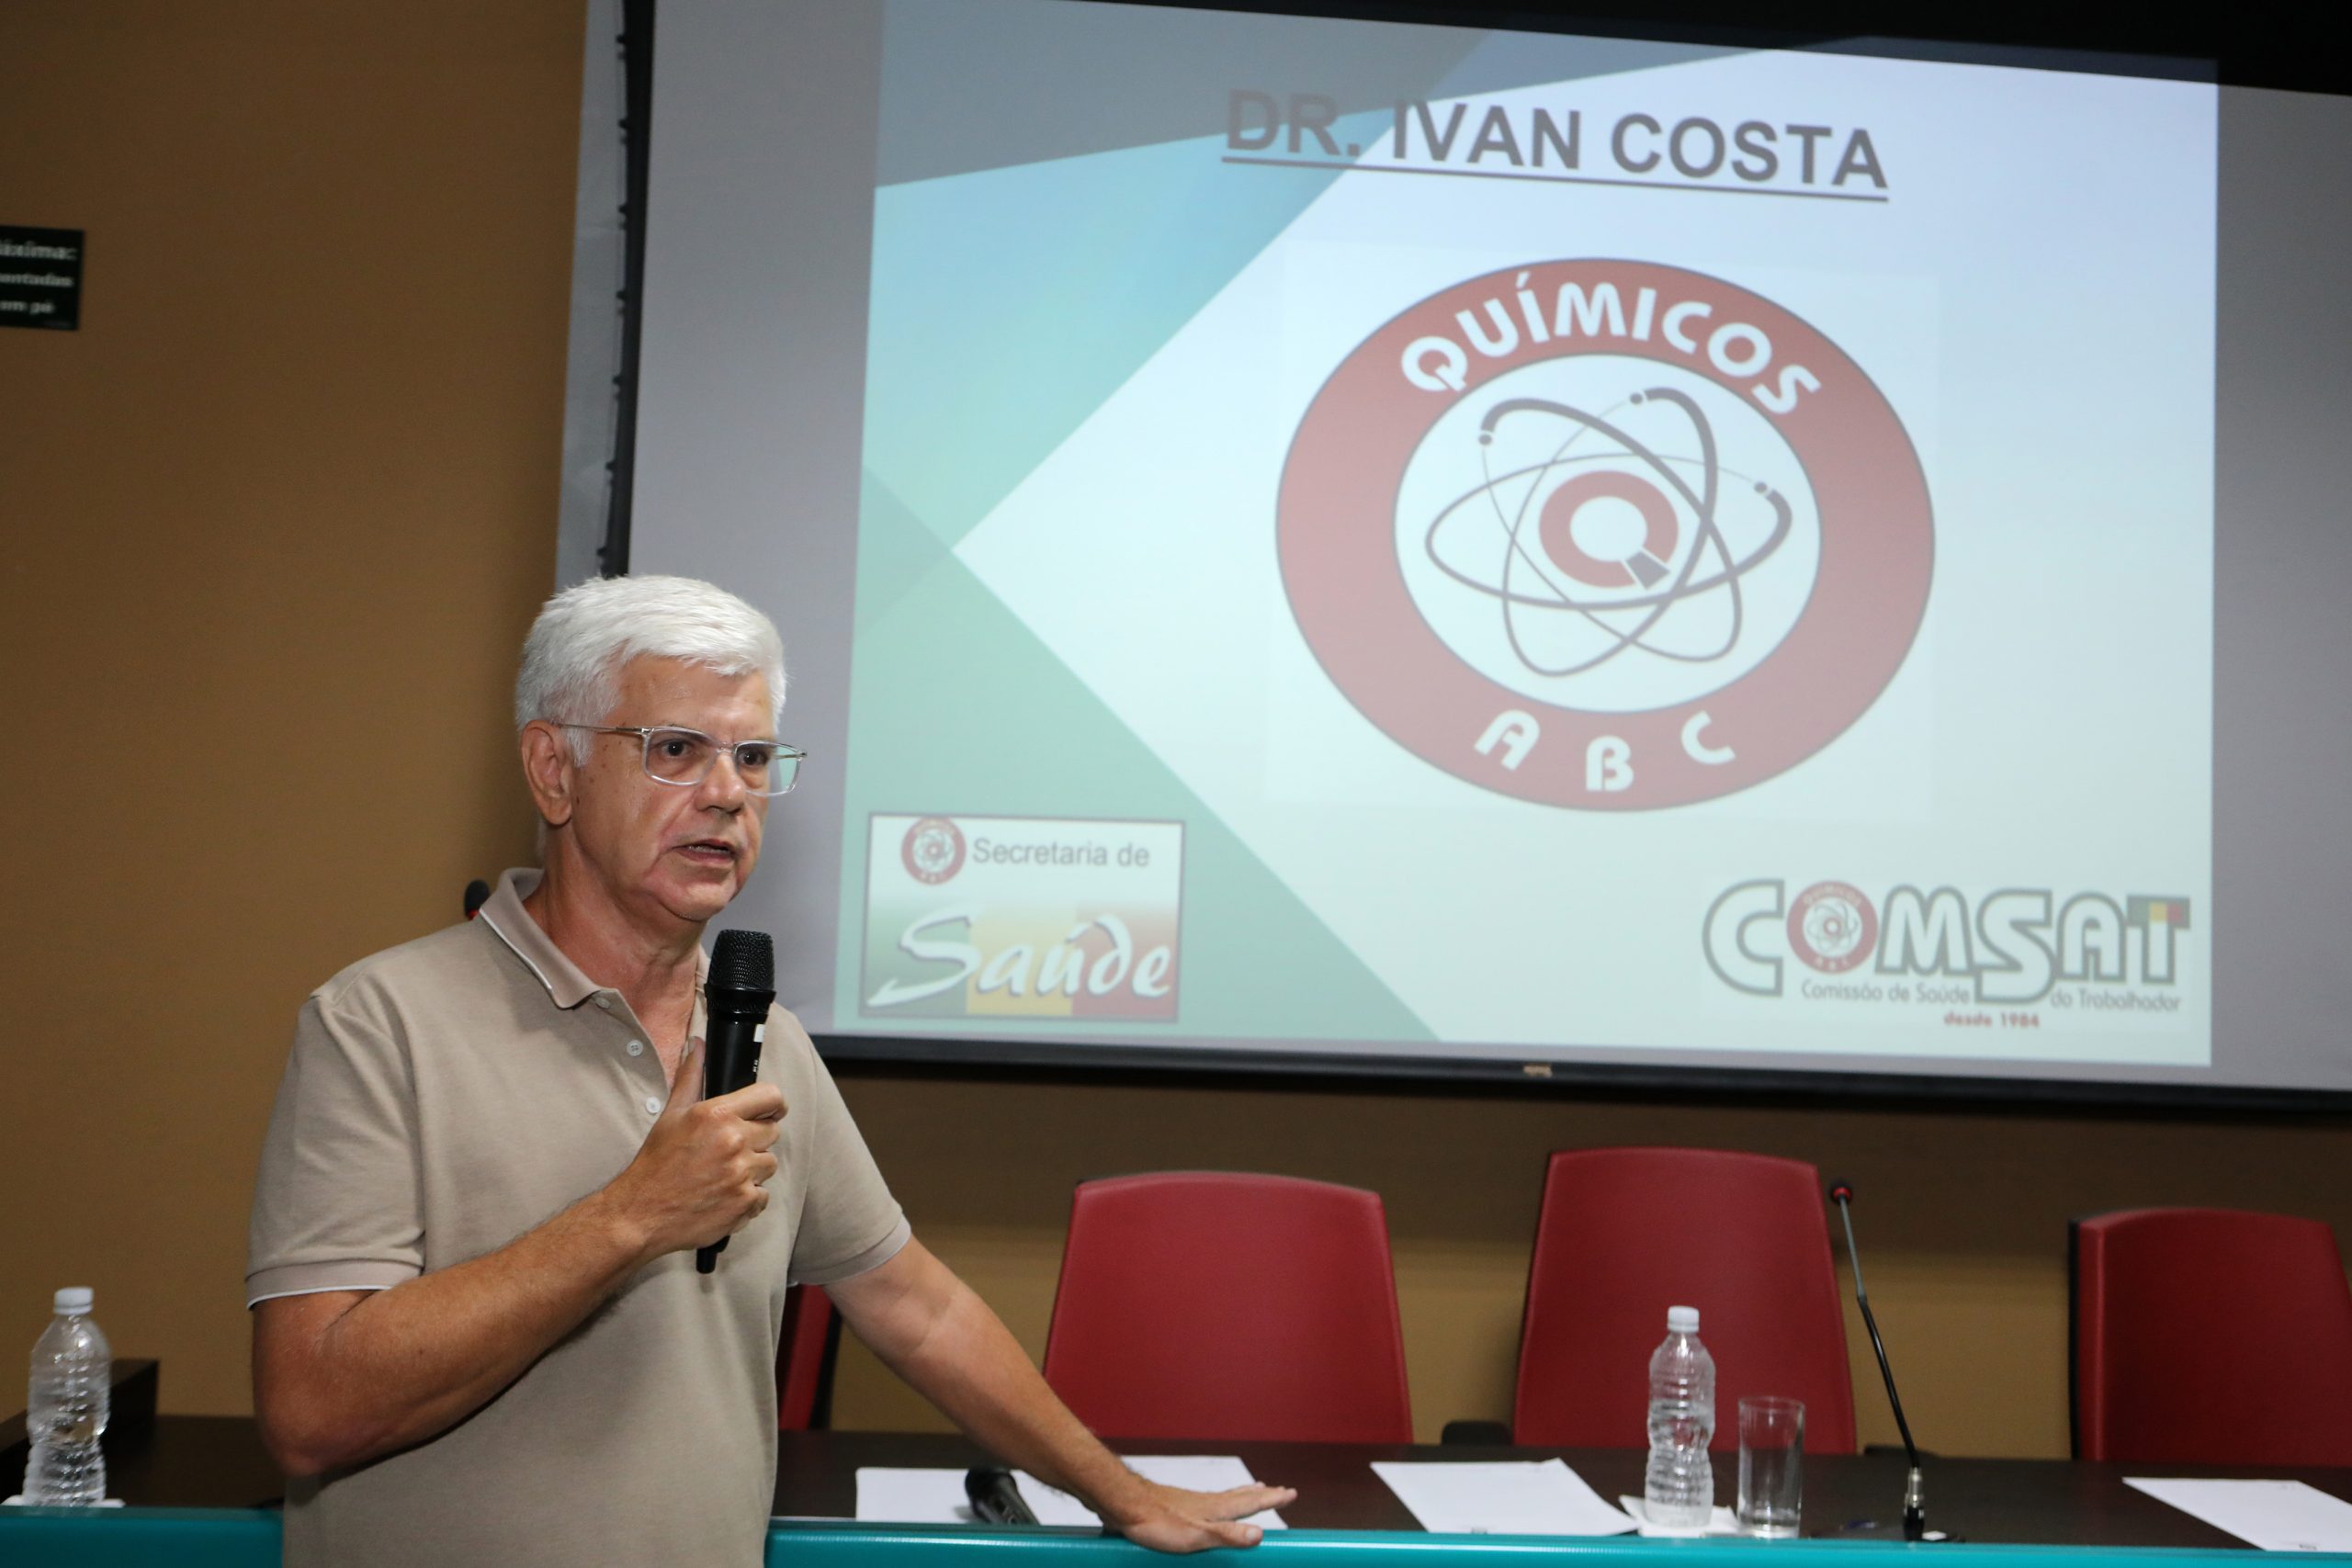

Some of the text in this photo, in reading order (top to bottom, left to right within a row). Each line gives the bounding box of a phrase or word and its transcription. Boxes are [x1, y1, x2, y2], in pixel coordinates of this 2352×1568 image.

[1226, 88, 1889, 188] DR. IVAN COSTA
[1401, 271, 1822, 415] QUÍMICOS
[972, 838, 1150, 867] Secretaria de
[866, 903, 1171, 1008] Saúde
[1888, 983, 1911, 1002] de
[2078, 987, 2182, 1012] Trabalhador
[1943, 1011, 1994, 1027] desde
